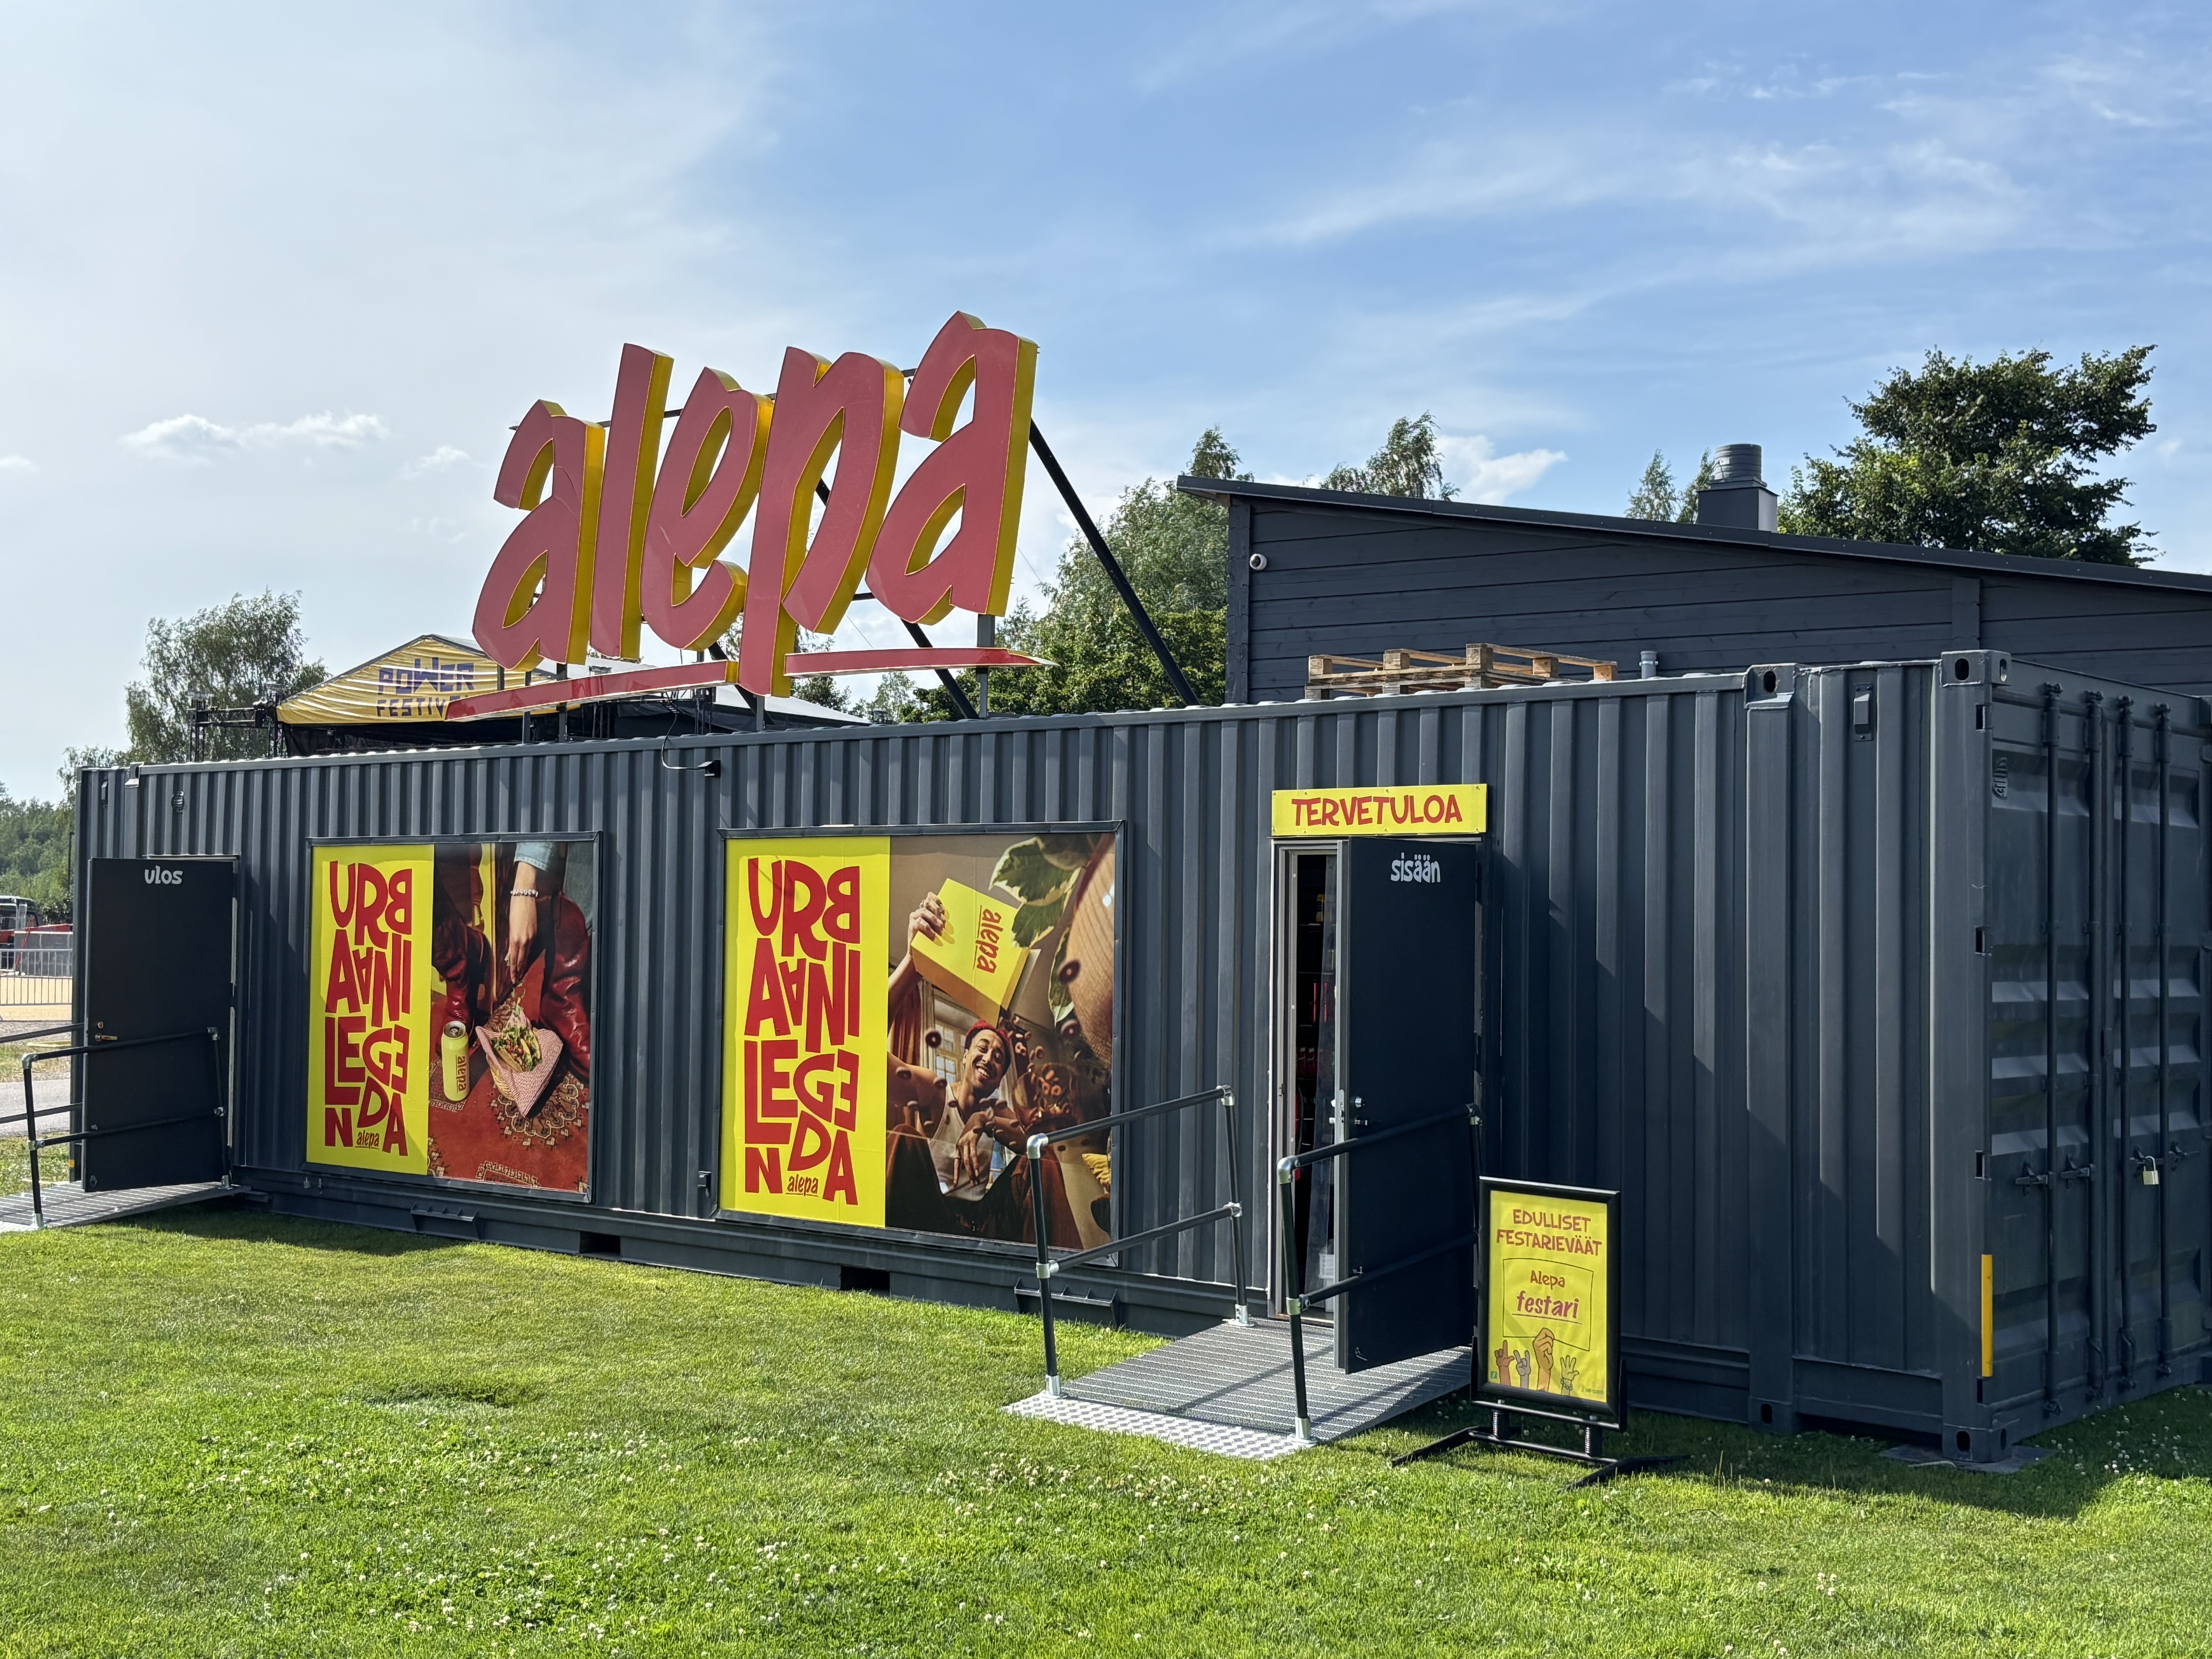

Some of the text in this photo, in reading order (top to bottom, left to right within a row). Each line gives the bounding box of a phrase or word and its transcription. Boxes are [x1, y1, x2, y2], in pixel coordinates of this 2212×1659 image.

[472, 311, 1039, 697] alepa
[378, 657, 475, 695] POWER
[376, 696, 469, 718] FESTIV
[1291, 794, 1463, 826] TERVETULOA
[144, 866, 183, 884] ulos
[1391, 853, 1441, 883] sisään
[975, 908, 1003, 973] alepa
[456, 1056, 467, 1091] alepa
[356, 1130, 380, 1149] alepa
[787, 1174, 819, 1197] alepa
[1513, 1209, 1591, 1233] EDULLISET
[1496, 1229, 1602, 1256] FESTARIEVÄÄT
[1530, 1270, 1565, 1290] Alepa
[1516, 1290, 1579, 1319] festari
